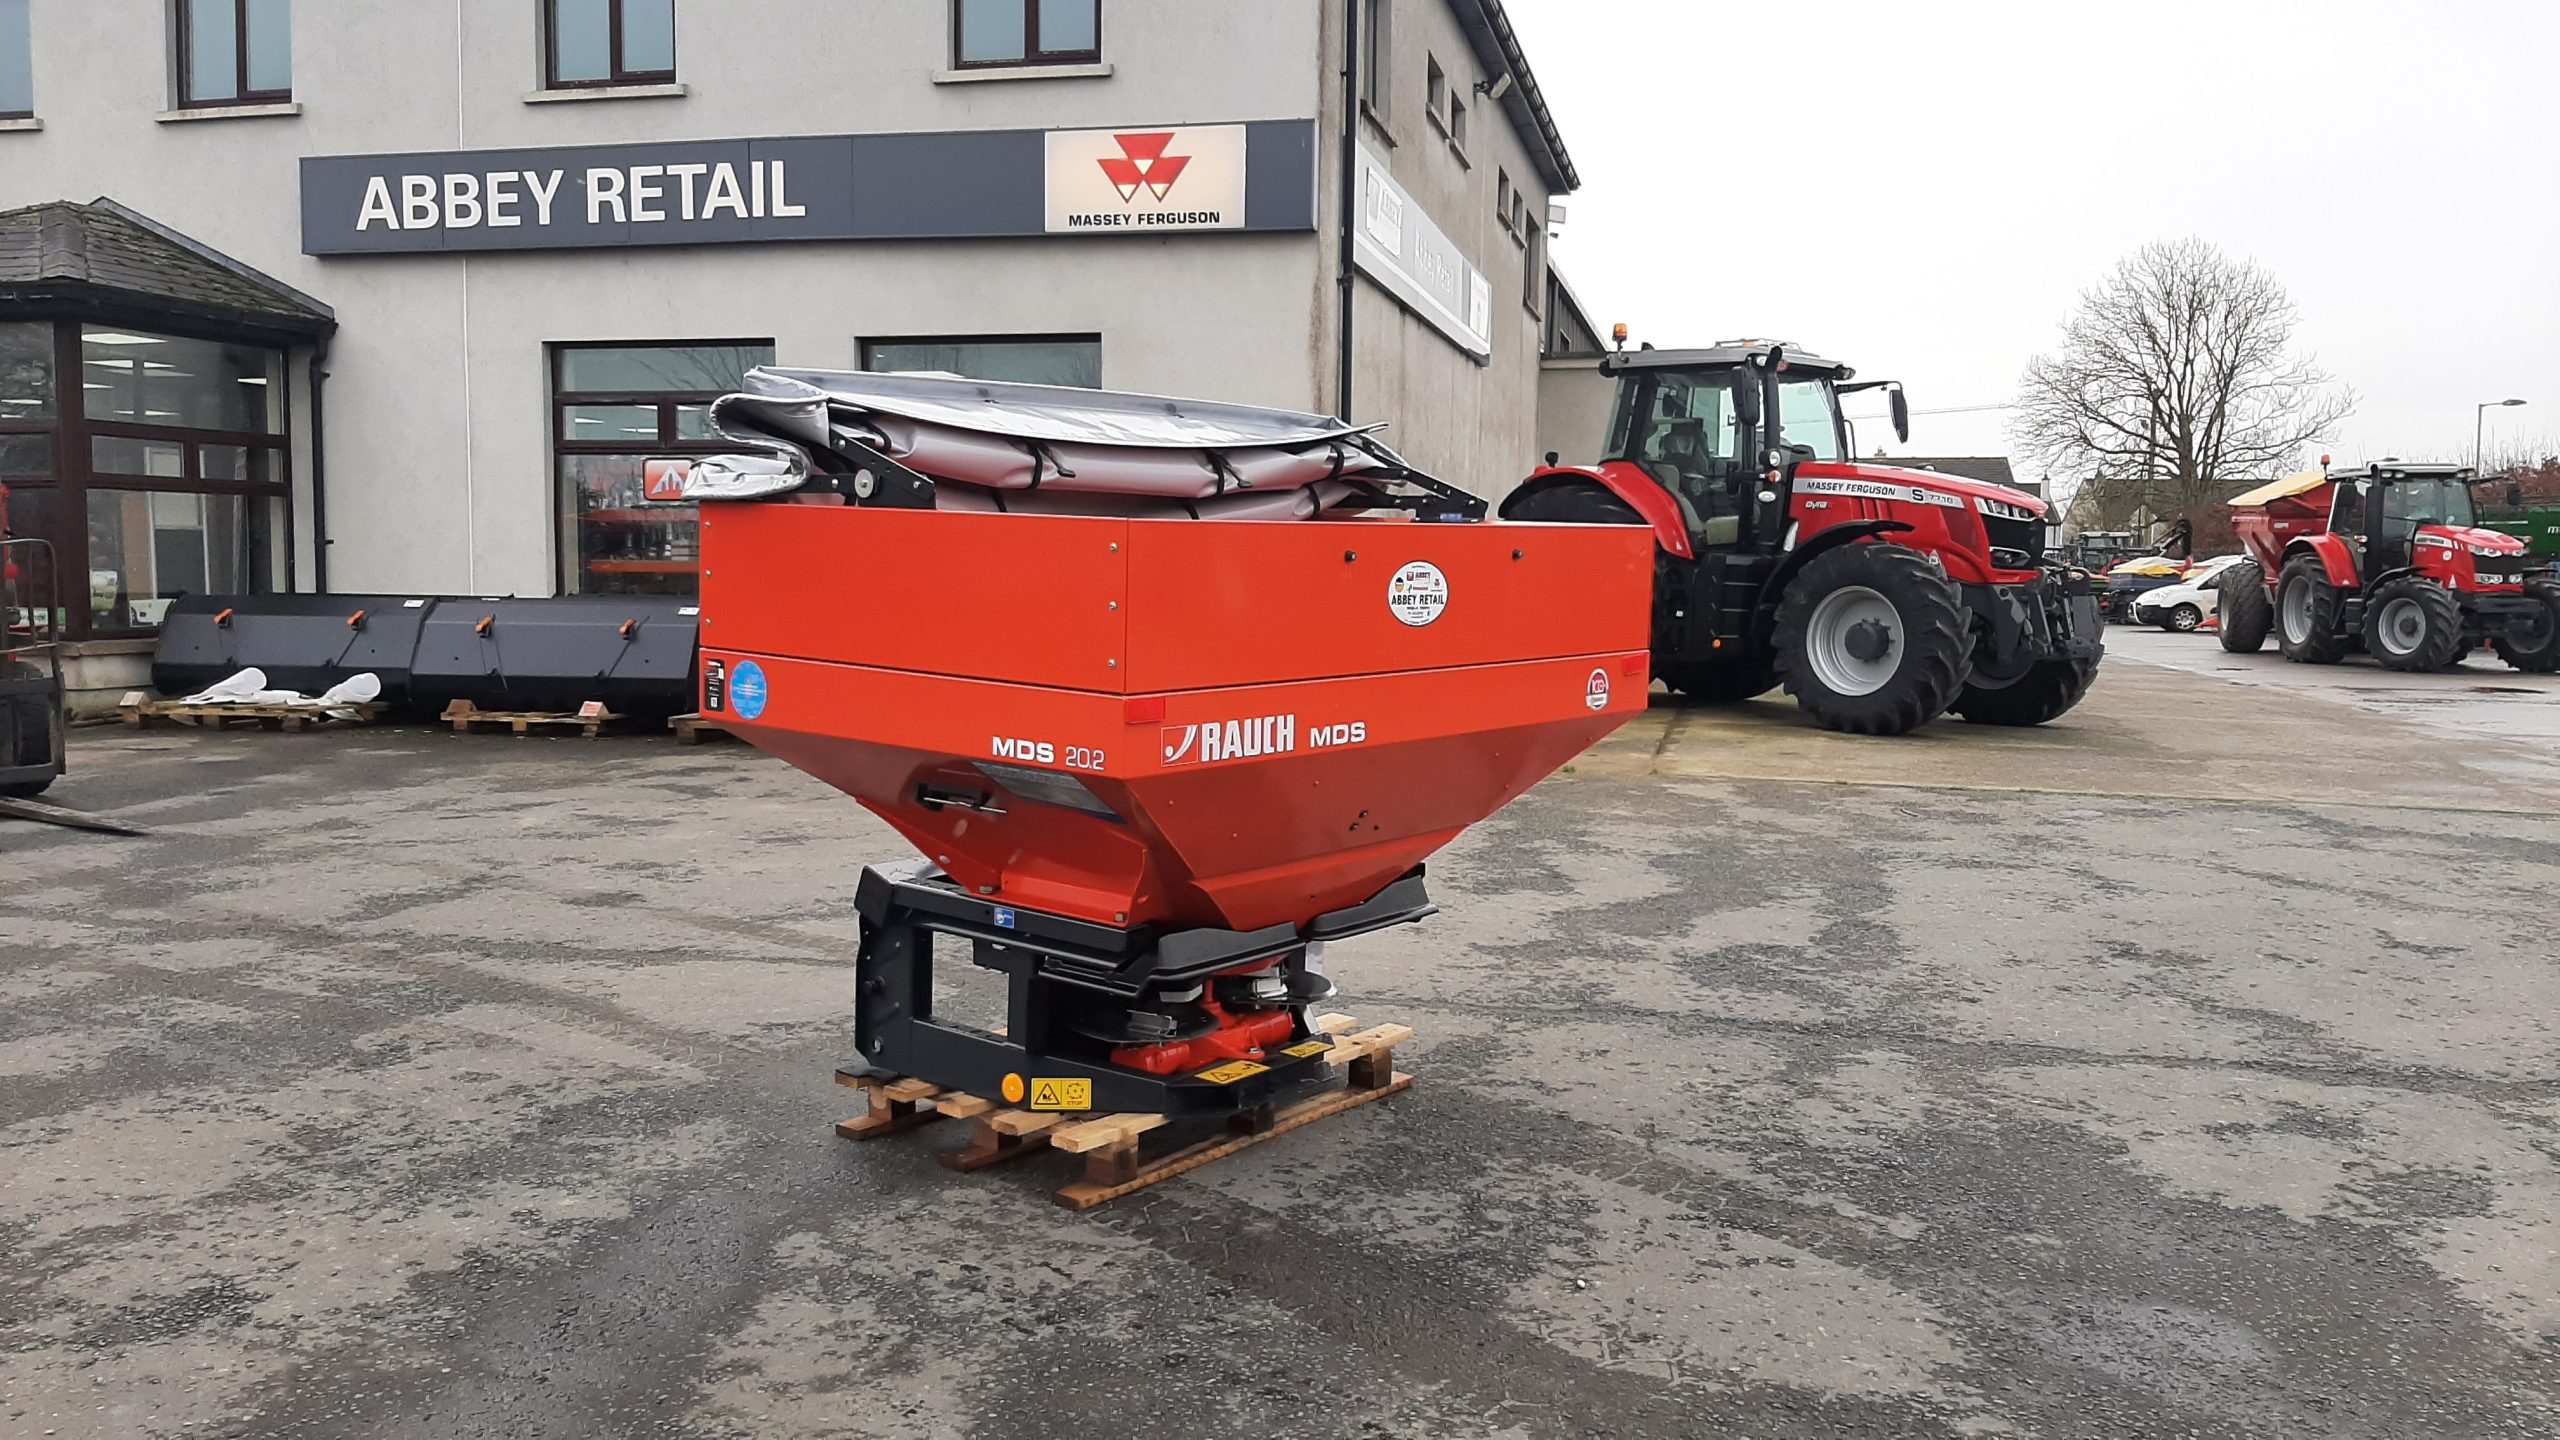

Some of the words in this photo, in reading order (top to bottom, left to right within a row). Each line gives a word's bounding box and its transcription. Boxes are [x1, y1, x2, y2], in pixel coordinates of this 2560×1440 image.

[355, 169, 565, 232] ABBEY
[586, 160, 806, 224] RETAIL
[1068, 213, 1132, 227] MASSEY
[1137, 211, 1220, 226] FERGUSON
[1806, 481, 1844, 492] MASSEY
[1845, 483, 1896, 496] FERGUSON
[1912, 489, 1924, 502] S
[1391, 594, 1417, 606] ABBEY
[1419, 593, 1444, 605] RETAIL
[1201, 714, 1295, 762] RAUCH
[1309, 721, 1366, 748] MDS
[992, 736, 1055, 764] MDS
[1065, 746, 1105, 770] 20.2
